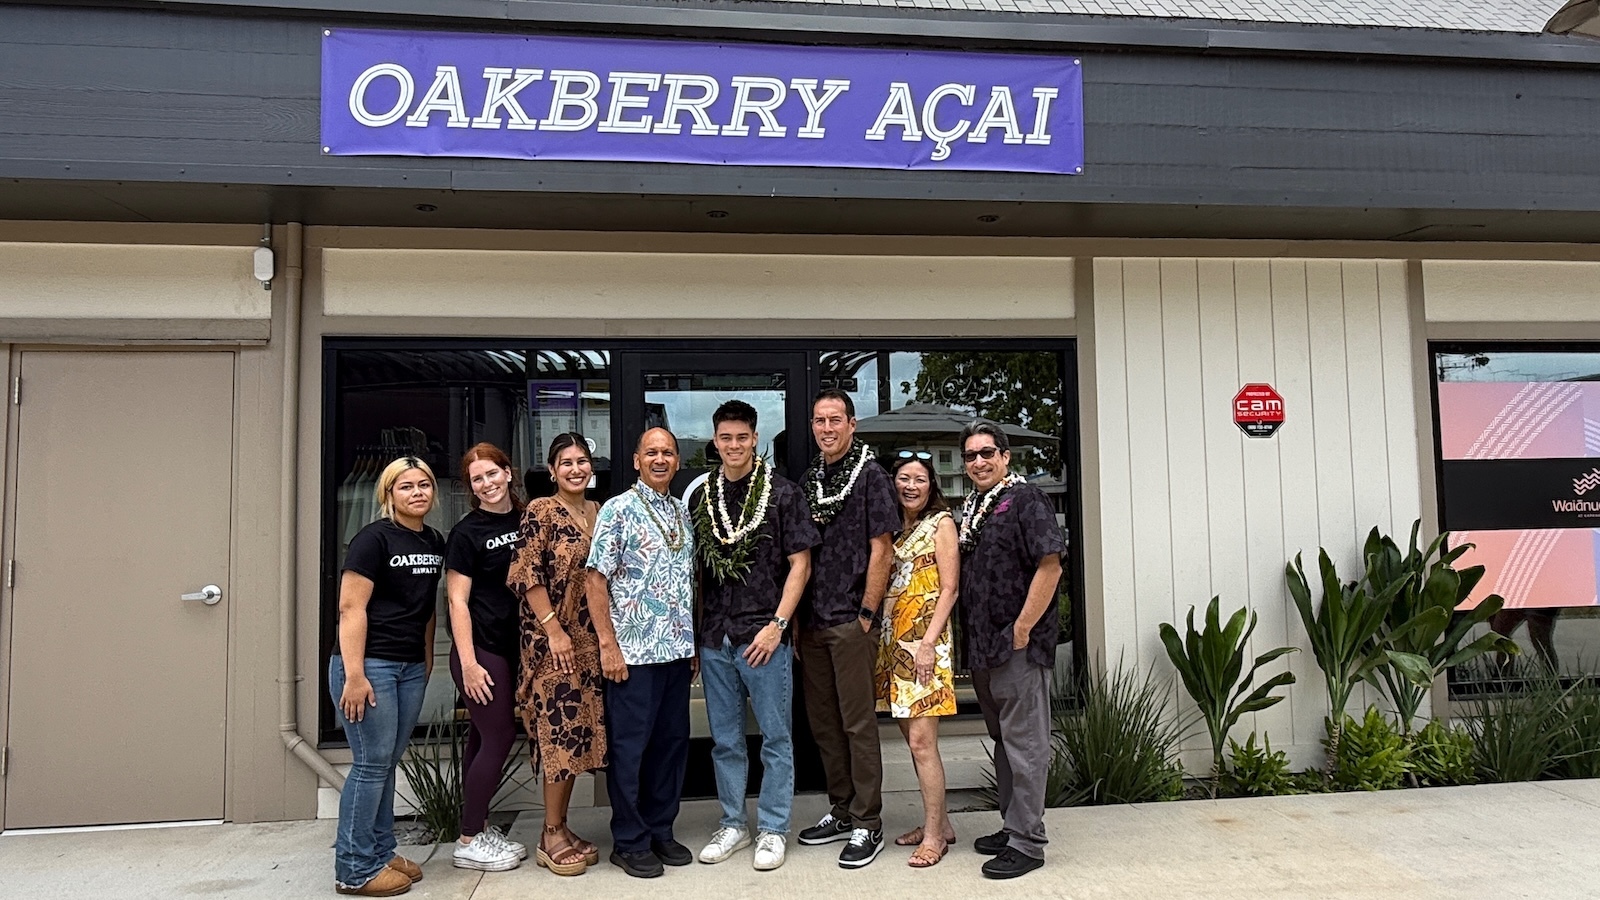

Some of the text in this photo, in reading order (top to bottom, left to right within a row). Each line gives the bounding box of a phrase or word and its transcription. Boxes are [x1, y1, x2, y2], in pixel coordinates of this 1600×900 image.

[348, 63, 1059, 161] OAKBERRY AÇAI
[1236, 400, 1282, 411] cam
[1551, 499, 1600, 512] Waiānu
